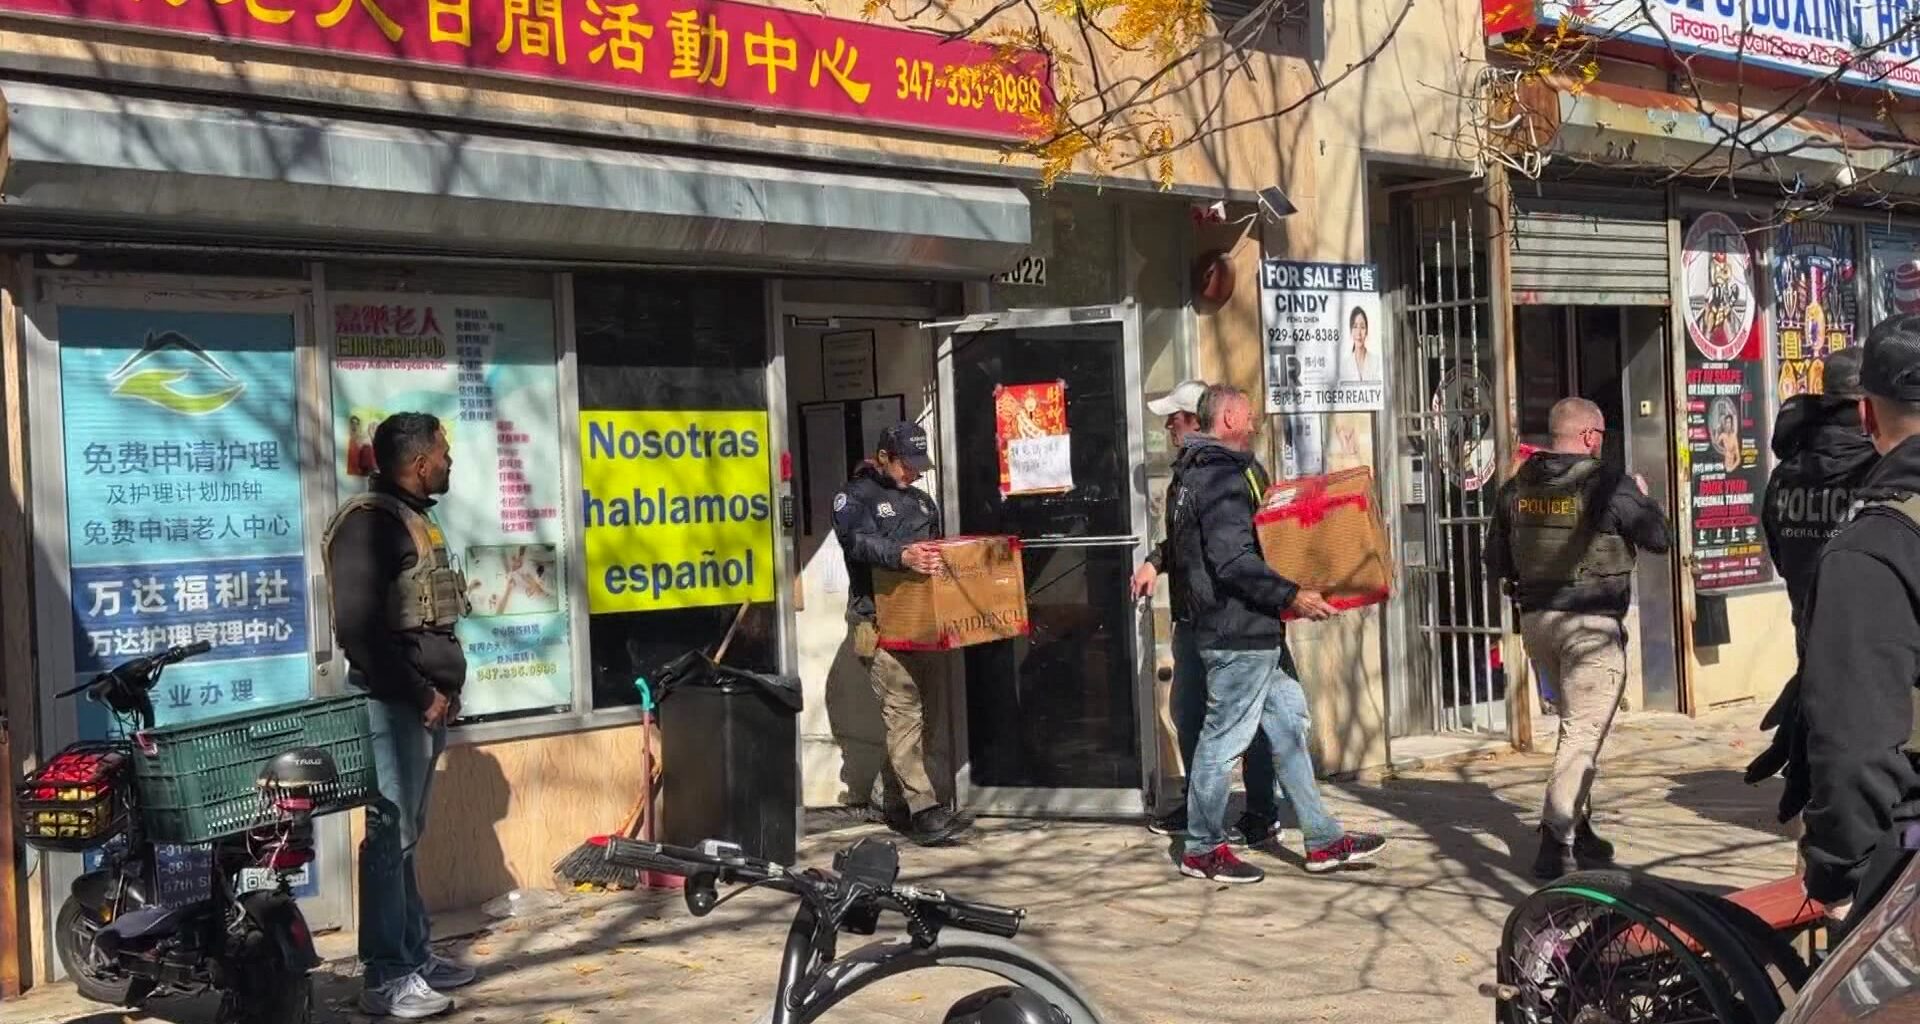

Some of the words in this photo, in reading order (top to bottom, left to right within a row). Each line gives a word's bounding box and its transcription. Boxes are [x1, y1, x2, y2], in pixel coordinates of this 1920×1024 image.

[1671, 12, 1718, 42] From
[1722, 24, 1768, 53] Level
[1834, 49, 1920, 83] Cmpetition
[1266, 264, 1300, 287] FOR
[1303, 266, 1344, 288] SALE
[1346, 267, 1374, 291] 出售
[1275, 293, 1329, 314] CINDY
[1268, 328, 1340, 342] 929-626-8388
[1272, 389, 1312, 406] 老虎地产
[1315, 390, 1344, 405] TIGER
[1346, 389, 1381, 404] REALTY
[588, 421, 759, 459] Nosotras
[82, 440, 281, 475] 免费申请护理
[106, 480, 263, 506] 及护理计划加钟
[1518, 498, 1571, 514] POLICE
[582, 488, 769, 528] hablamos
[83, 514, 291, 546] 免费申请老人中心
[604, 549, 753, 600] español
[87, 569, 290, 617] 万达福利社
[87, 618, 294, 657] 万达护理管理中心
